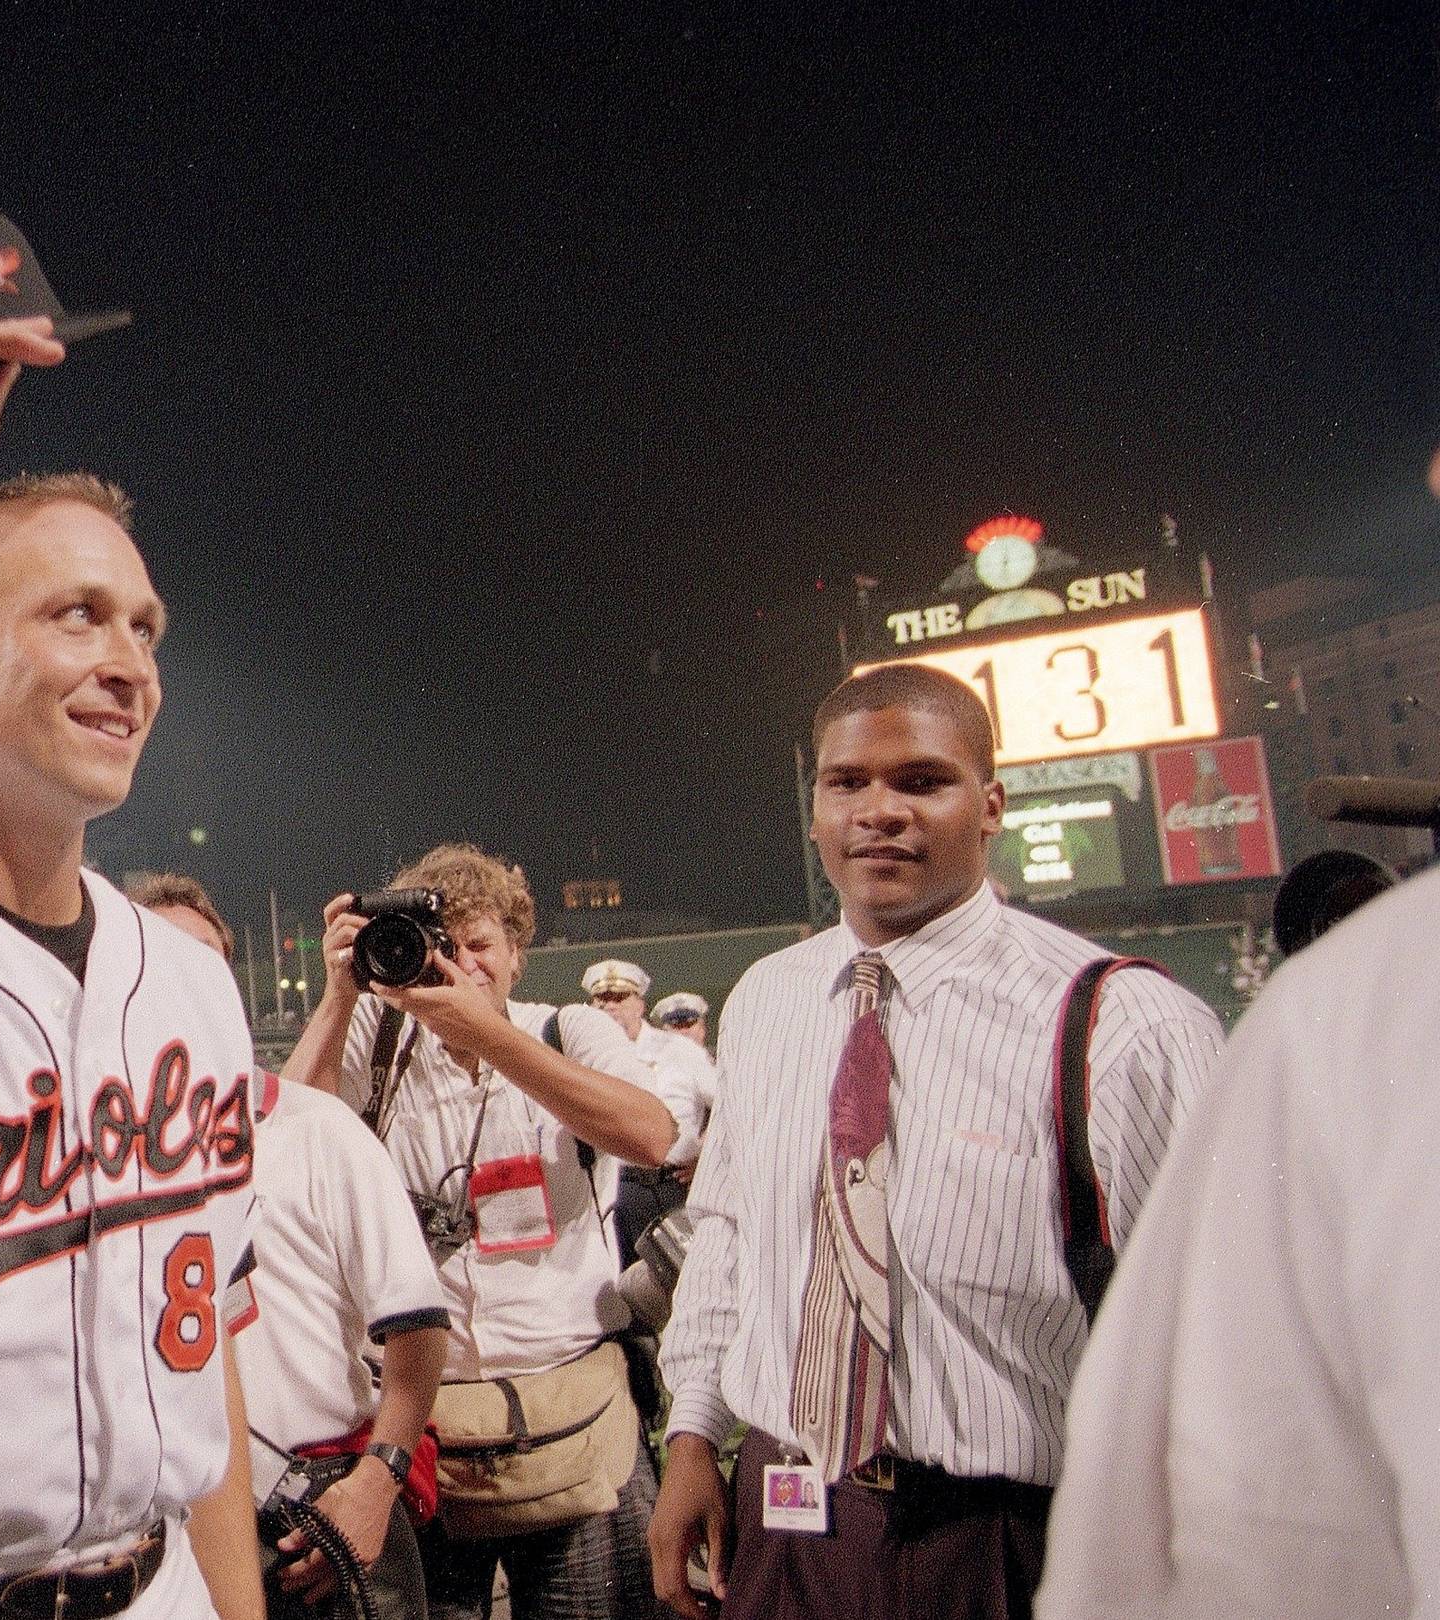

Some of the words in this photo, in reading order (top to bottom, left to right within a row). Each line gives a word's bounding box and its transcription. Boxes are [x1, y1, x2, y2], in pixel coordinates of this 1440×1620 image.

[887, 603, 963, 645] THE
[1067, 568, 1146, 612] SUN
[153, 1232, 217, 1372] 8
